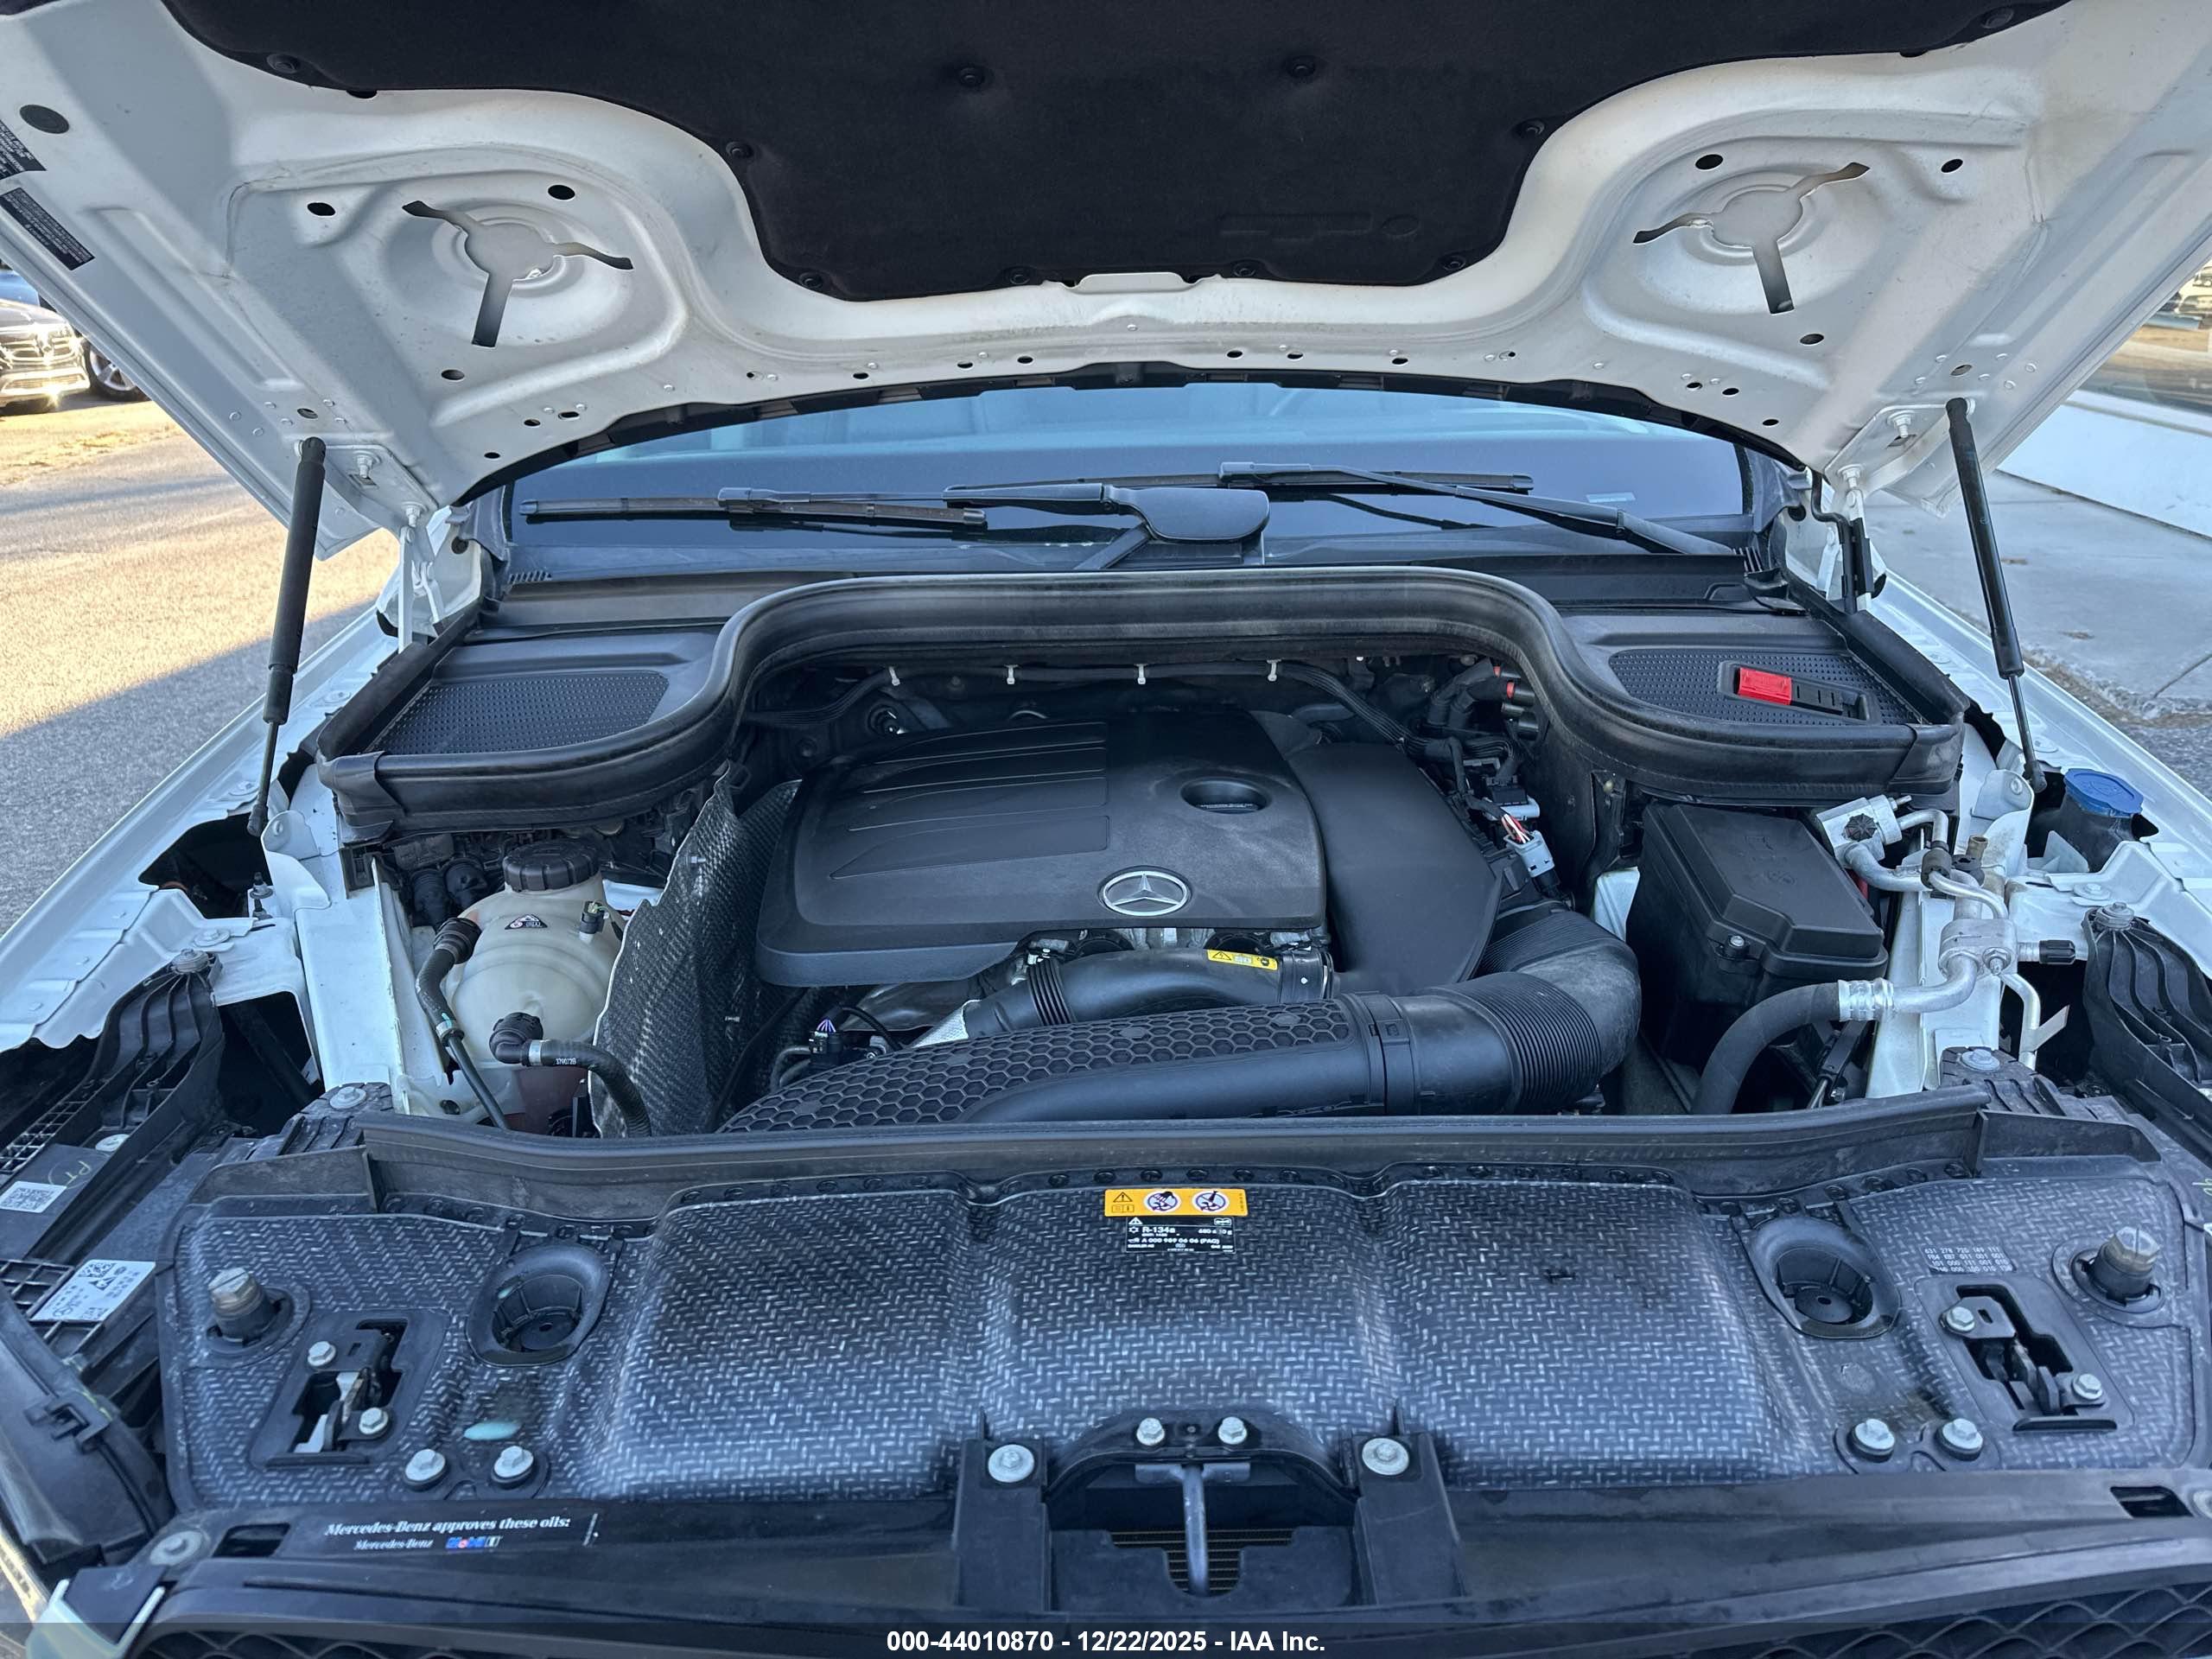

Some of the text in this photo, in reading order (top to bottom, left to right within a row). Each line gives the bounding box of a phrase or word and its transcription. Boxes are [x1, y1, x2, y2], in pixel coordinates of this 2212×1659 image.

[325, 1516, 571, 1535] Mercedes-Benz approves these oils:
[353, 1539, 434, 1551] Mercedes-Benz
